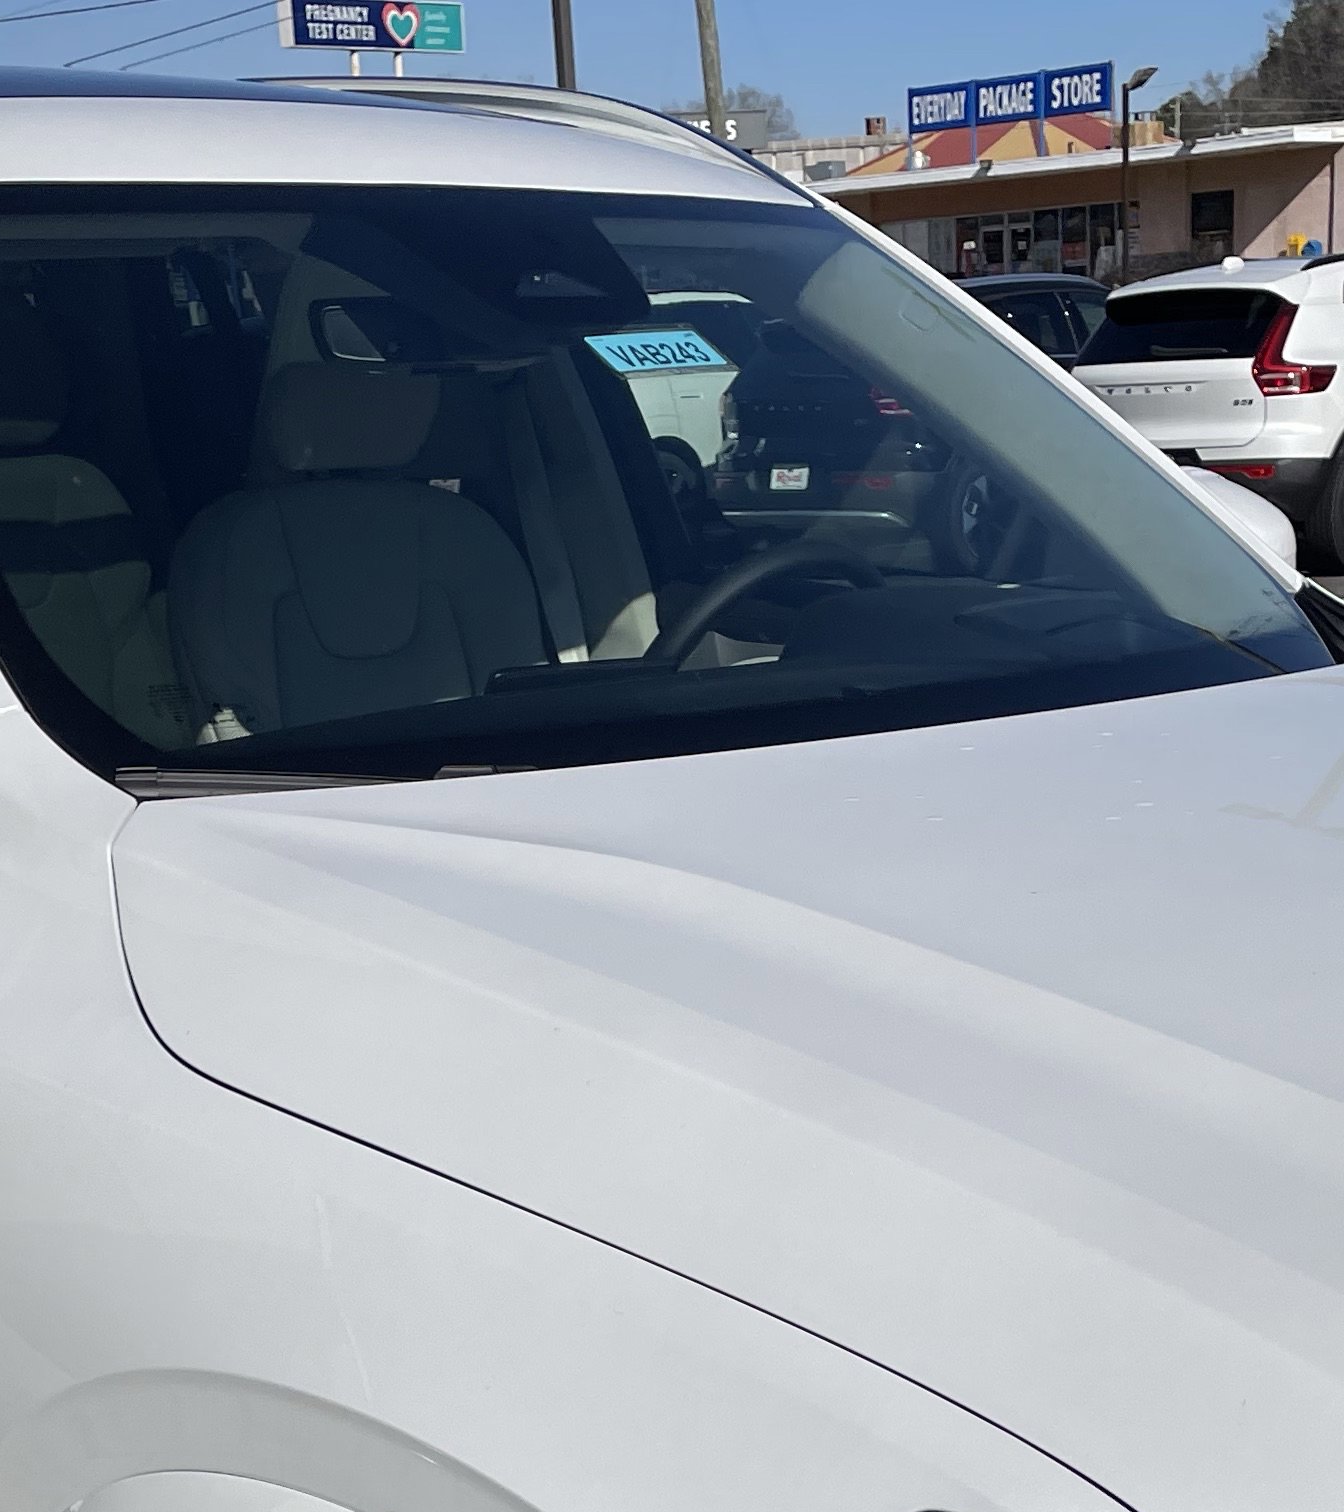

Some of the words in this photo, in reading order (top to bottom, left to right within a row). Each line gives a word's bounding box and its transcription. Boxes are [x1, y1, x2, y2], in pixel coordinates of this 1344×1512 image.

[305, 4, 369, 22] PREGNANCY
[307, 23, 335, 39] TEST
[336, 24, 376, 41] CENTER
[911, 90, 967, 126] EVERYDAY
[978, 81, 1035, 119] PACKAGE
[1051, 72, 1103, 109] STORE
[604, 341, 711, 367] VAB243
